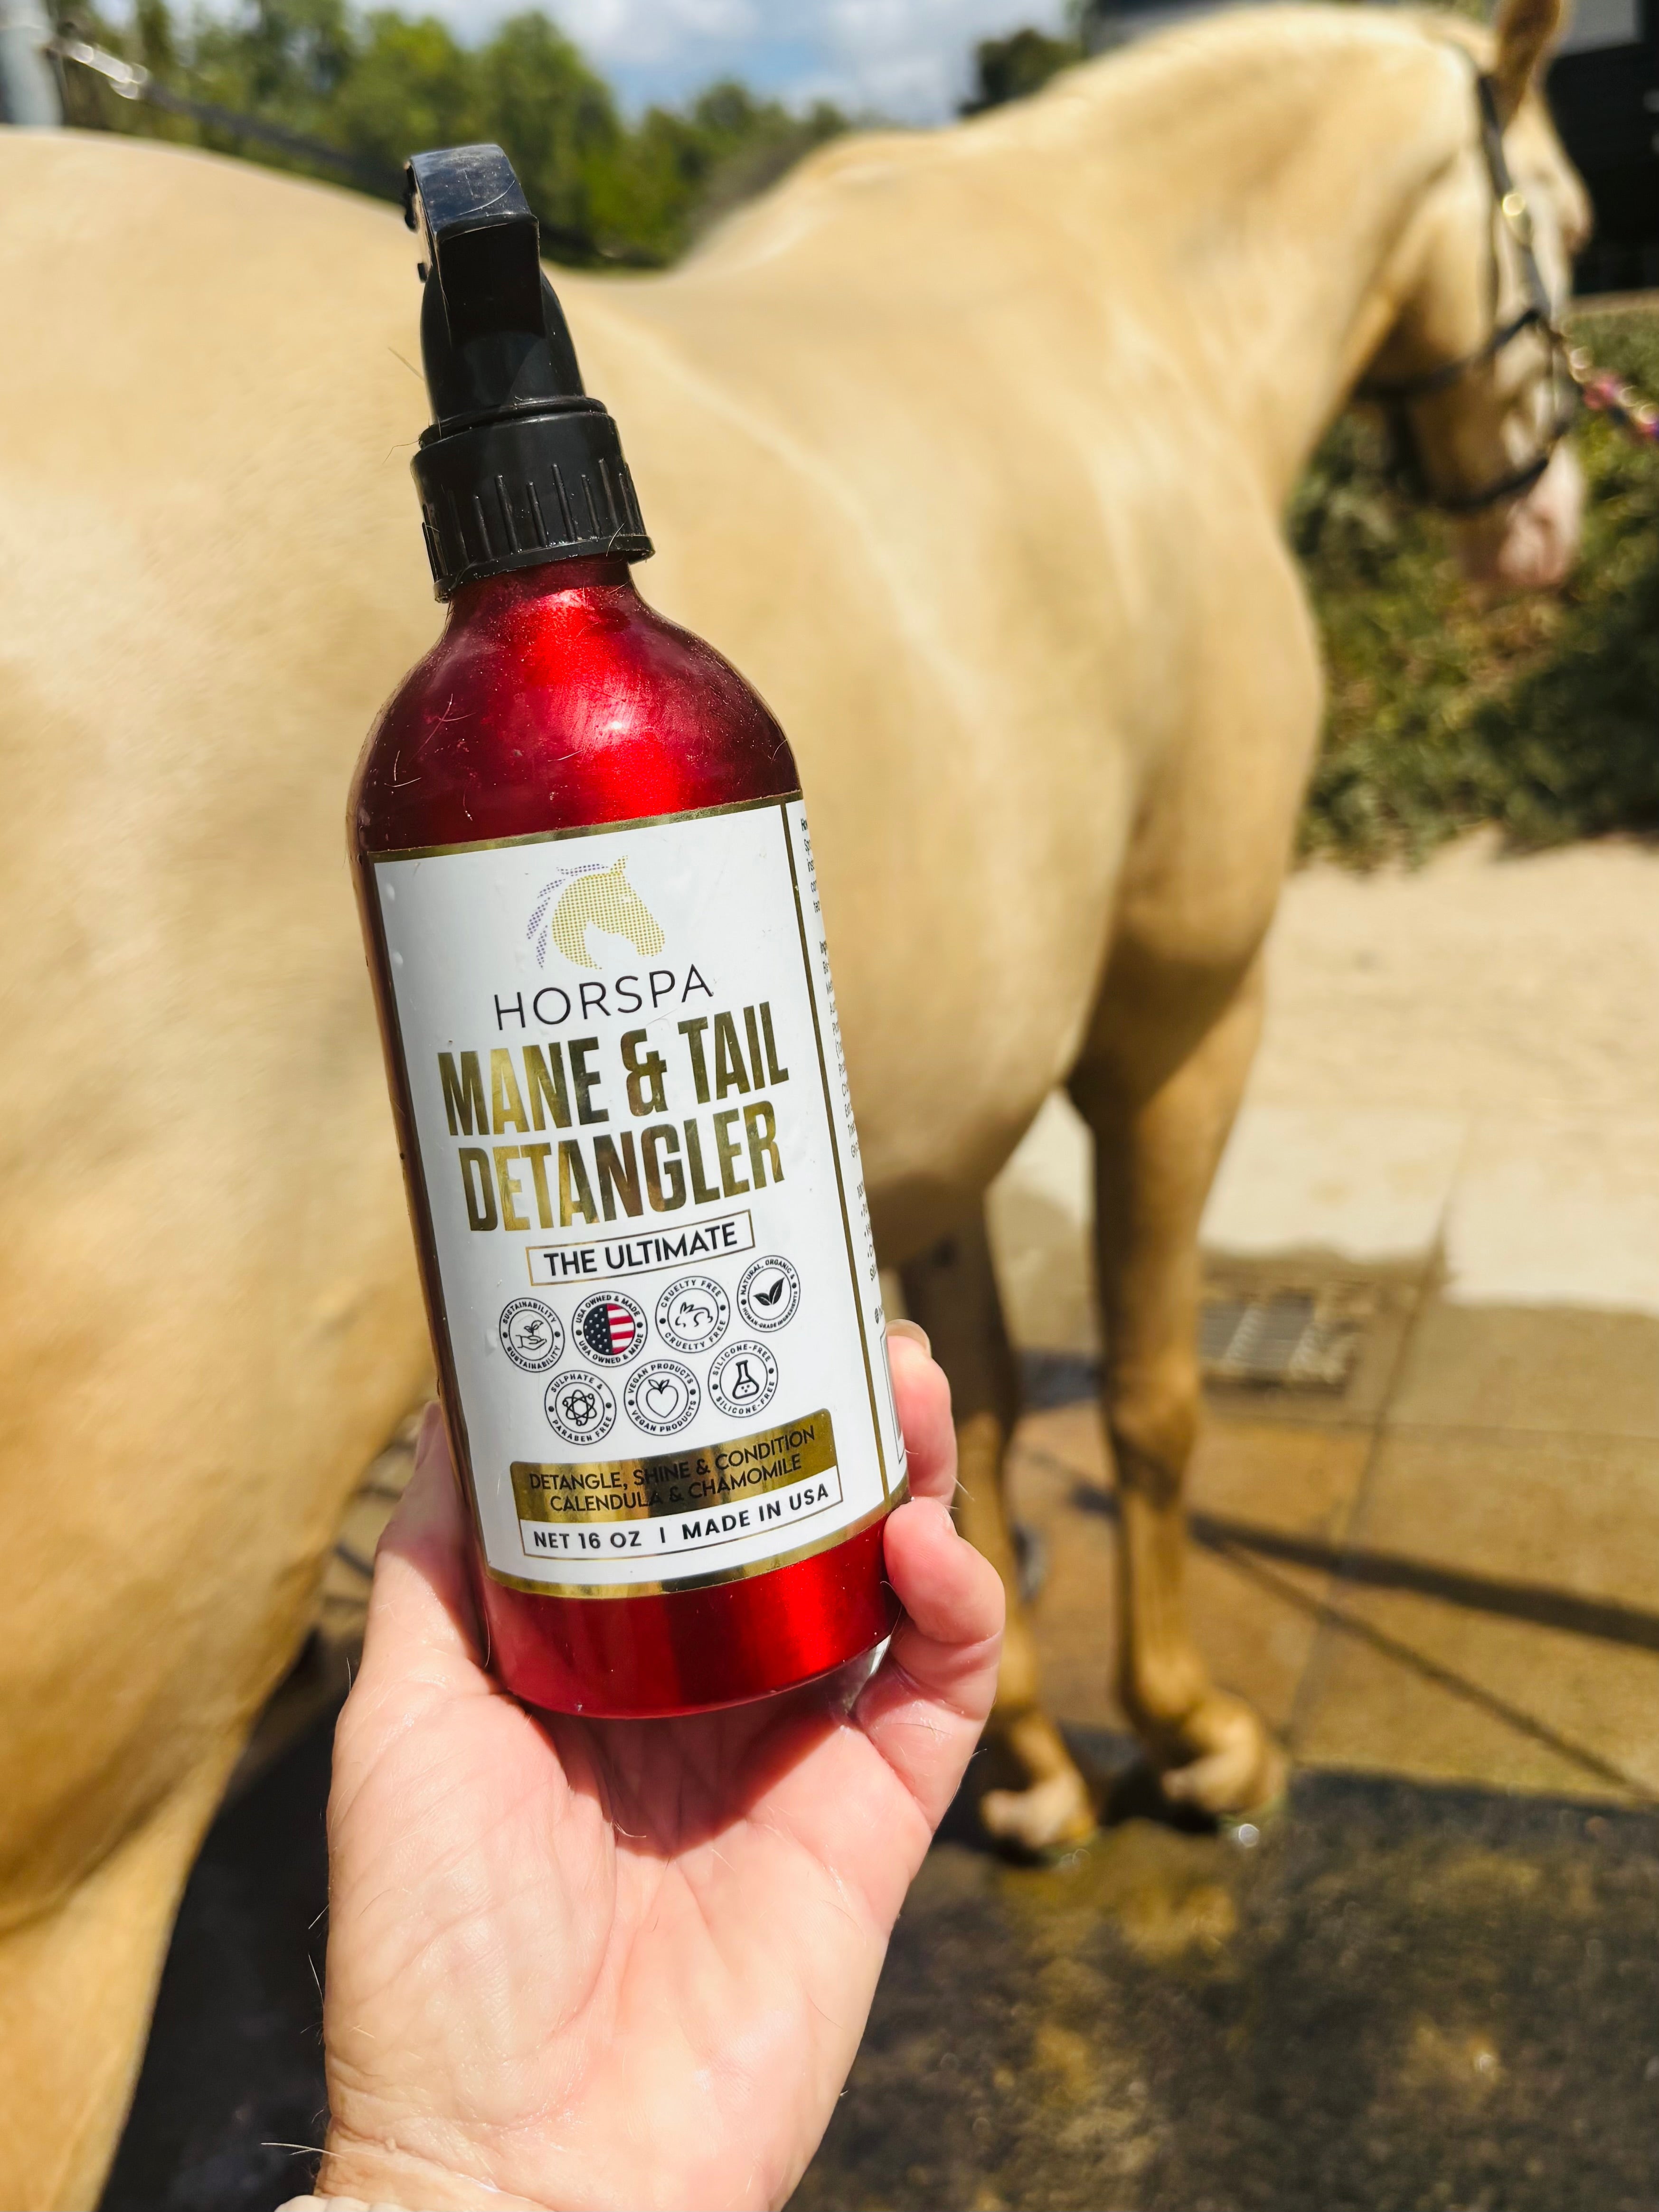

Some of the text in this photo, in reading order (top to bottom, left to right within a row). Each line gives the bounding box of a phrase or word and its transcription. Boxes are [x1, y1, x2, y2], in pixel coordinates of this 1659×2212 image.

[494, 964, 714, 1031] HORSPA
[438, 1001, 789, 1136] MANE & TAIL
[458, 1101, 784, 1231] DETANGLER
[544, 1223, 737, 1276] THE ULTIMATE
[740, 1264, 764, 1295] NATURAL,
[765, 1259, 792, 1273] ORGANIC
[576, 1309, 586, 1323] USA
[585, 1295, 611, 1308] OWNED
[622, 1298, 640, 1317] MADE
[661, 1280, 721, 1308] CRUELTY FREE
[503, 1301, 556, 1324] SUSTAINABILITY
[743, 1307, 777, 1328] HUMAN-GRADE
[579, 1340, 591, 1355] USA
[593, 1354, 621, 1364] OWNED
[629, 1333, 643, 1355] MADE
[665, 1320, 726, 1350] CRUELTY FREE
[507, 1346, 560, 1369] SUSTAINABILITY
[712, 1344, 771, 1375] SILICONE-FREE
[551, 1374, 594, 1393] SULPHATE
[628, 1363, 693, 1393] VEGAN PRODUCTS
[716, 1382, 774, 1414] SILICONE-FREE
[552, 1416, 612, 1442] PARABEN FREE
[632, 1401, 696, 1432] VEGAN PRODUCTS
[529, 1425, 815, 1490] DETANGLE, SHINE & CONDITION
[550, 1453, 802, 1512] CALENDULA & CHAMOMILE
[534, 1531, 569, 1549] NET
[578, 1532, 601, 1549] 16
[610, 1530, 642, 1548] OZ
[682, 1509, 751, 1540] MADE
[759, 1500, 781, 1522] IN
[789, 1483, 829, 1511] USA
